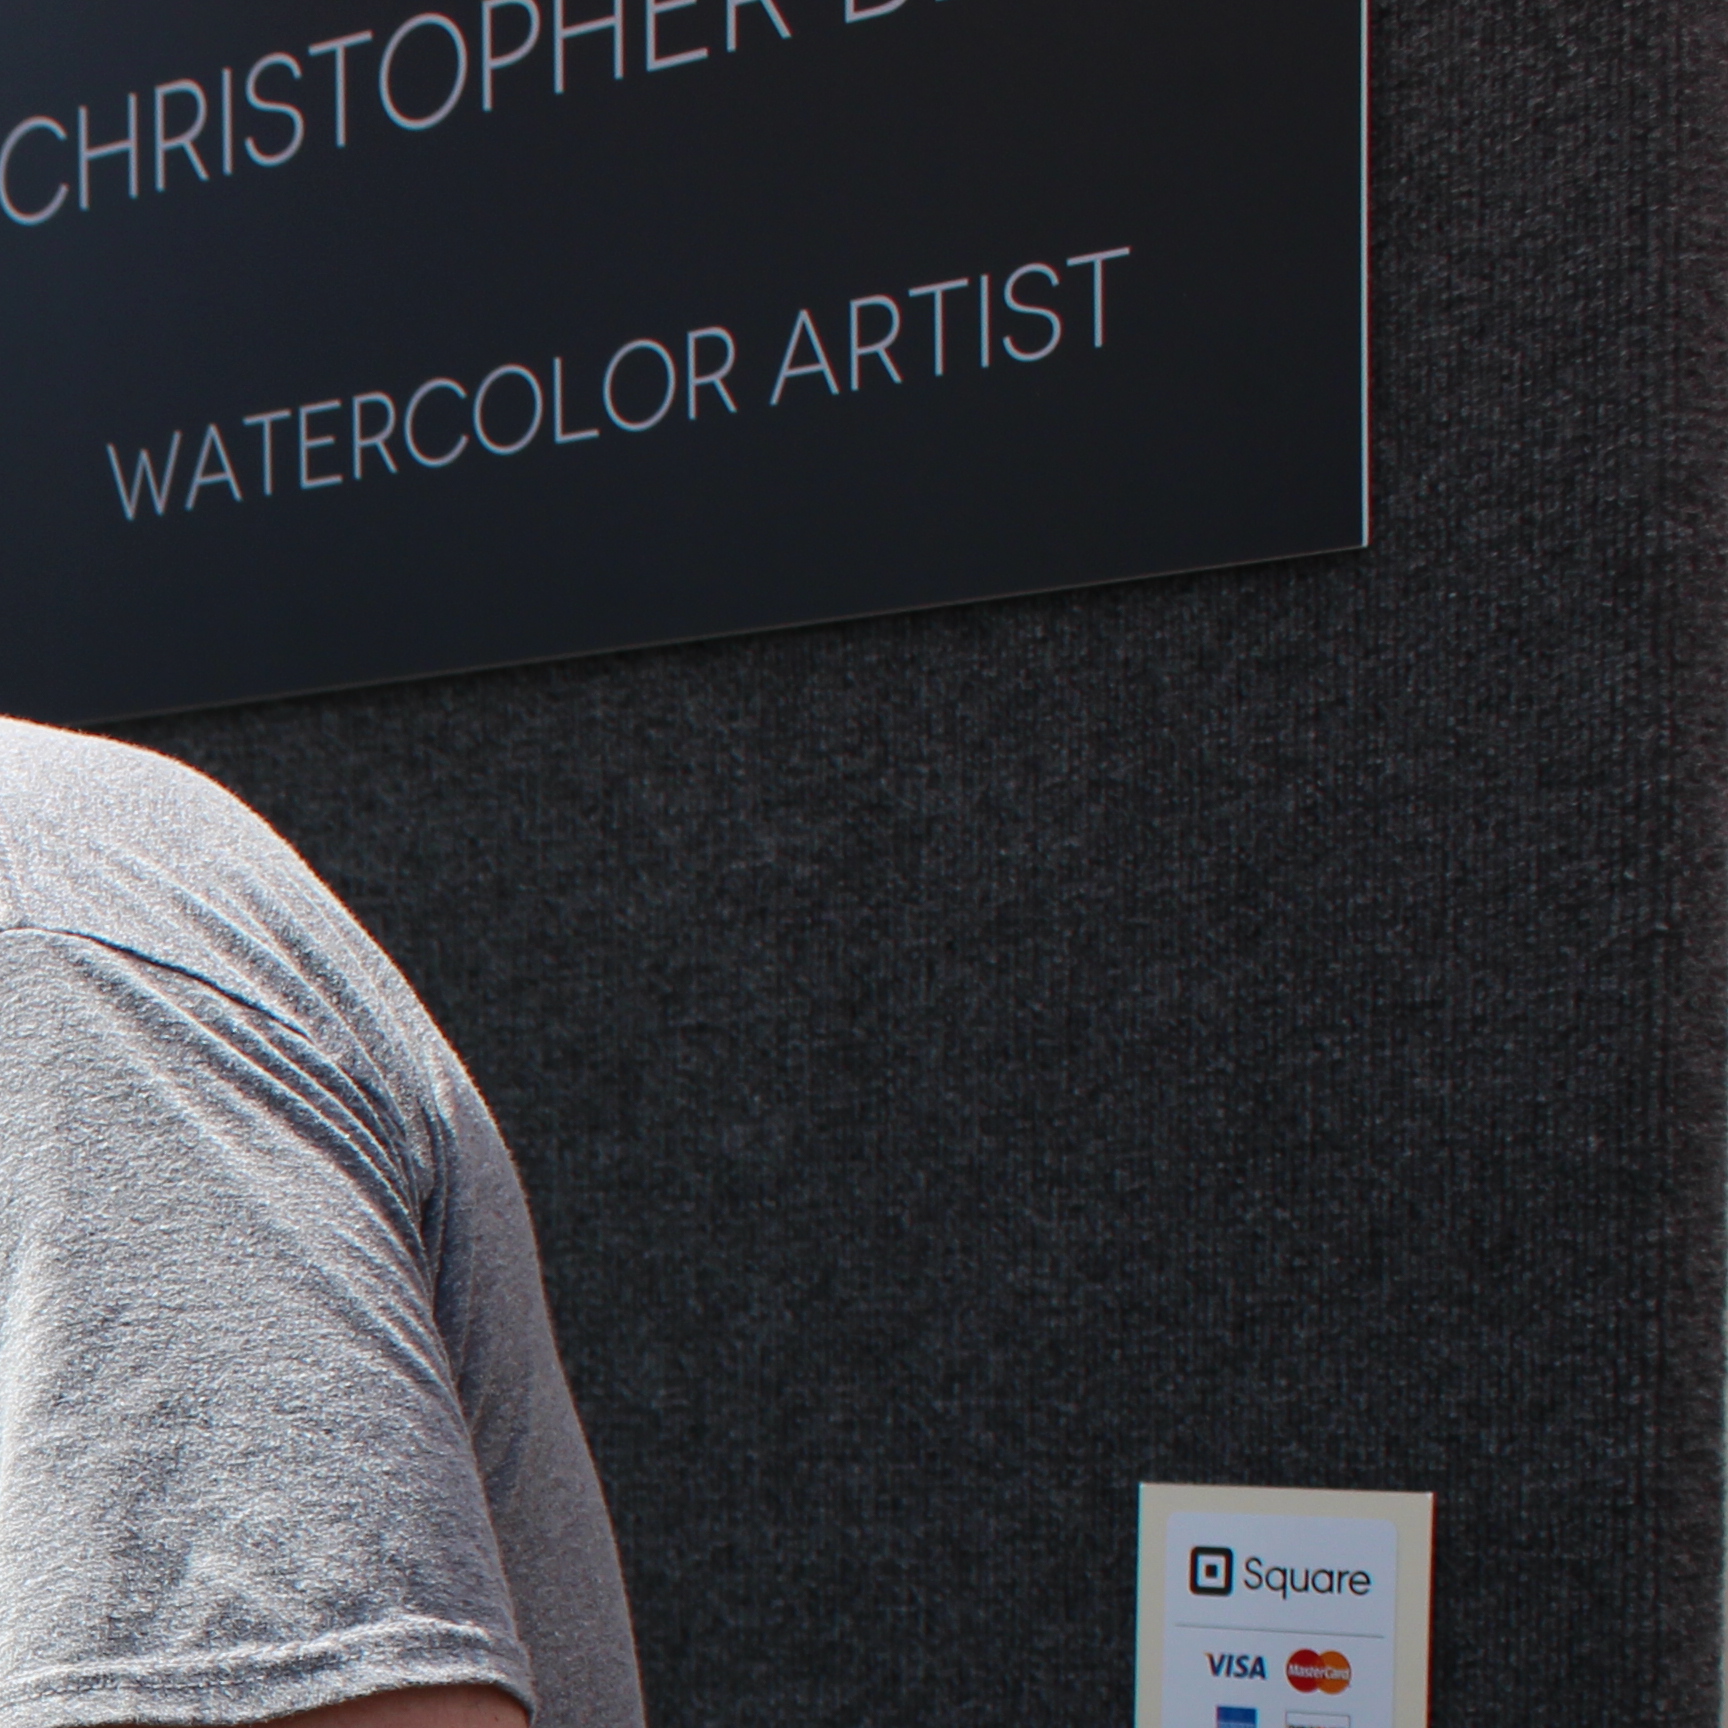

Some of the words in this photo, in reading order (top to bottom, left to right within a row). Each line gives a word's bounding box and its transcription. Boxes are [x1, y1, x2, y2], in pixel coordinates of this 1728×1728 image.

[106, 326, 738, 520] WATERCOLOR
[770, 246, 1131, 405] ARTIST
[1243, 1555, 1372, 1601] Square
[1205, 1653, 1268, 1681] VISA
[1287, 1663, 1350, 1681] MasterCard
